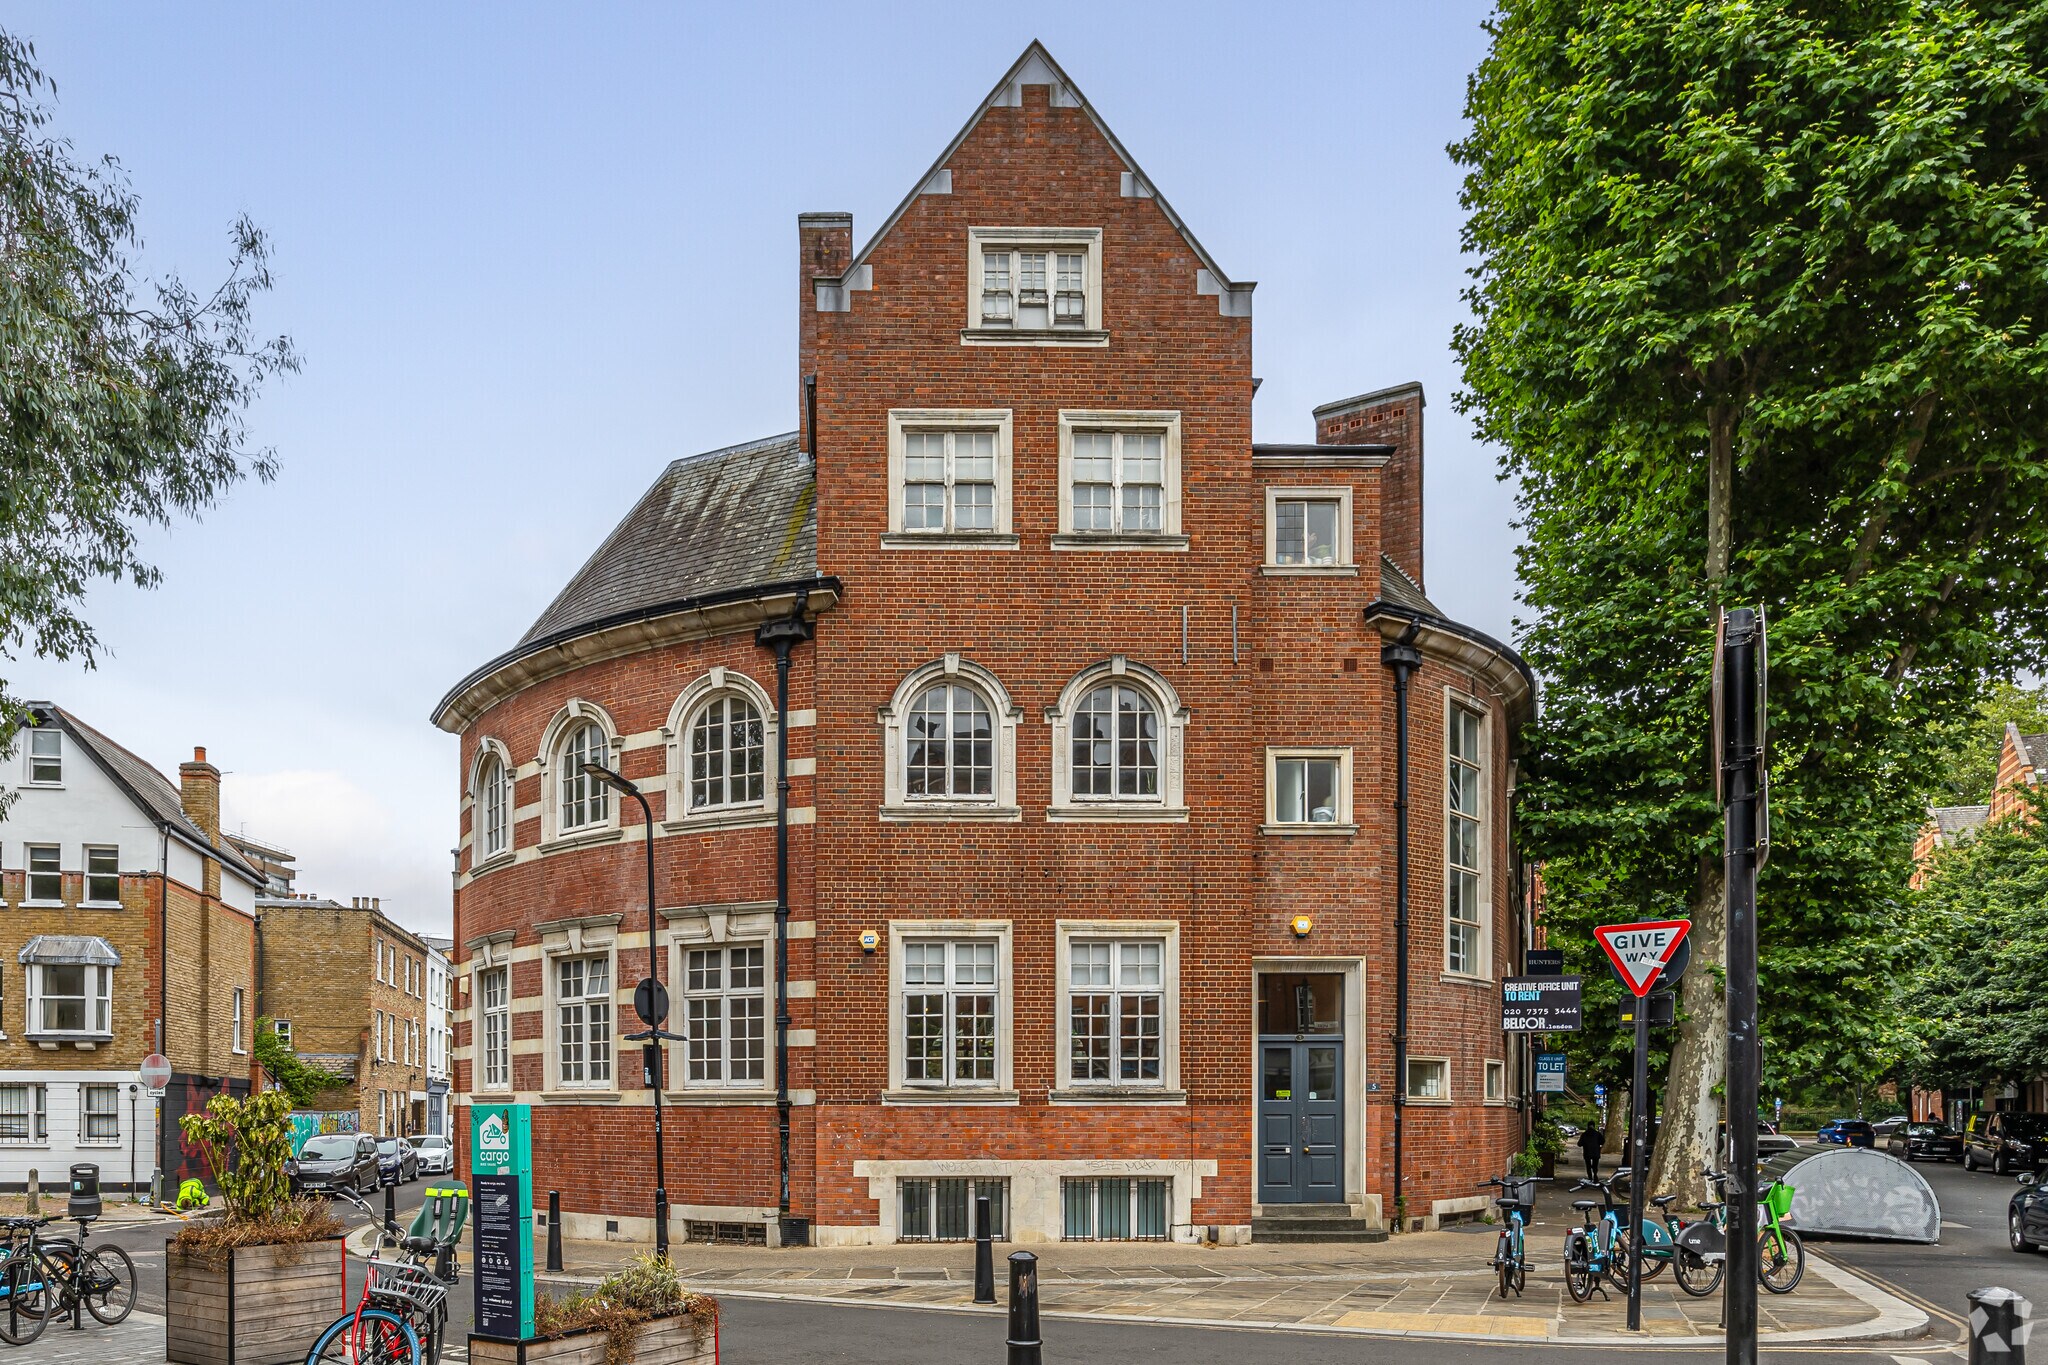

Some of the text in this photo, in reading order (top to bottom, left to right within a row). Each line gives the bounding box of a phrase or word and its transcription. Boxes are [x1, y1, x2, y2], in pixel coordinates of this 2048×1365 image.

[1614, 933, 1665, 949] GIVE
[1625, 951, 1658, 962] WAY
[1504, 981, 1579, 991] CREATIVE OFFICE UNIT
[1504, 991, 1541, 1001] TO RENT
[1554, 1007, 1578, 1015] 3444
[1538, 1062, 1564, 1070] TO LET
[480, 1151, 510, 1164] cargo
